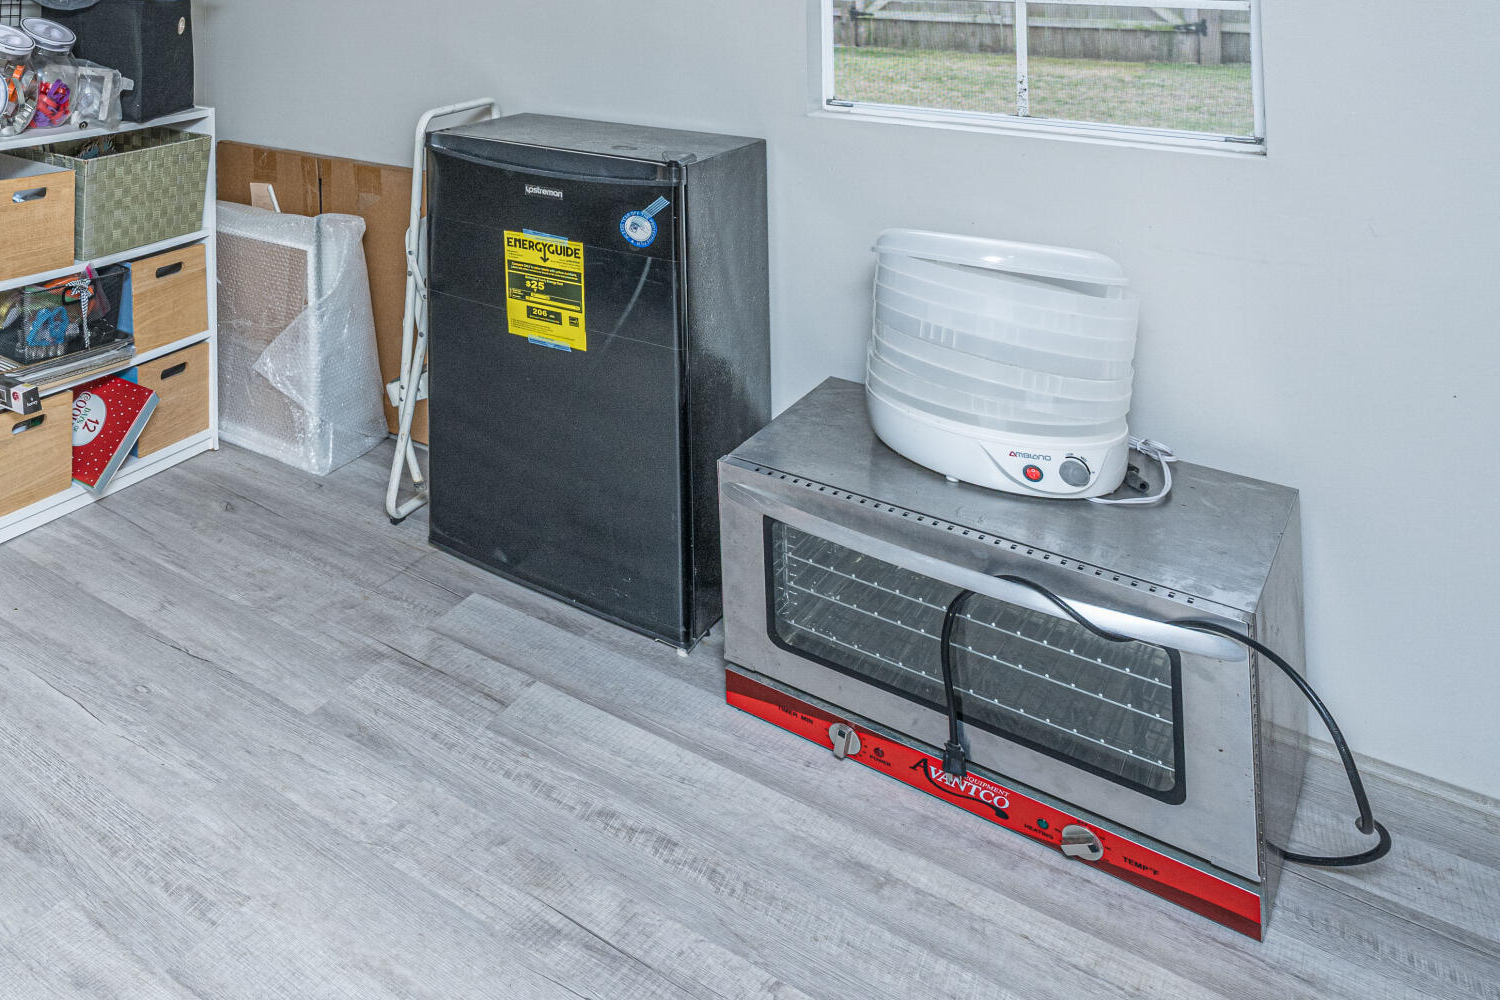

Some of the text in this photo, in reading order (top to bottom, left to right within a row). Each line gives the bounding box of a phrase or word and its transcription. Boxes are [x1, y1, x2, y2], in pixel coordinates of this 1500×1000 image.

[507, 237, 581, 260] ENERGYGUIDE
[525, 280, 545, 291] $25
[532, 308, 547, 317] 206
[82, 418, 99, 433] 12
[801, 715, 814, 724] MIN
[869, 754, 891, 766] POWER
[1024, 823, 1053, 839] HEATING
